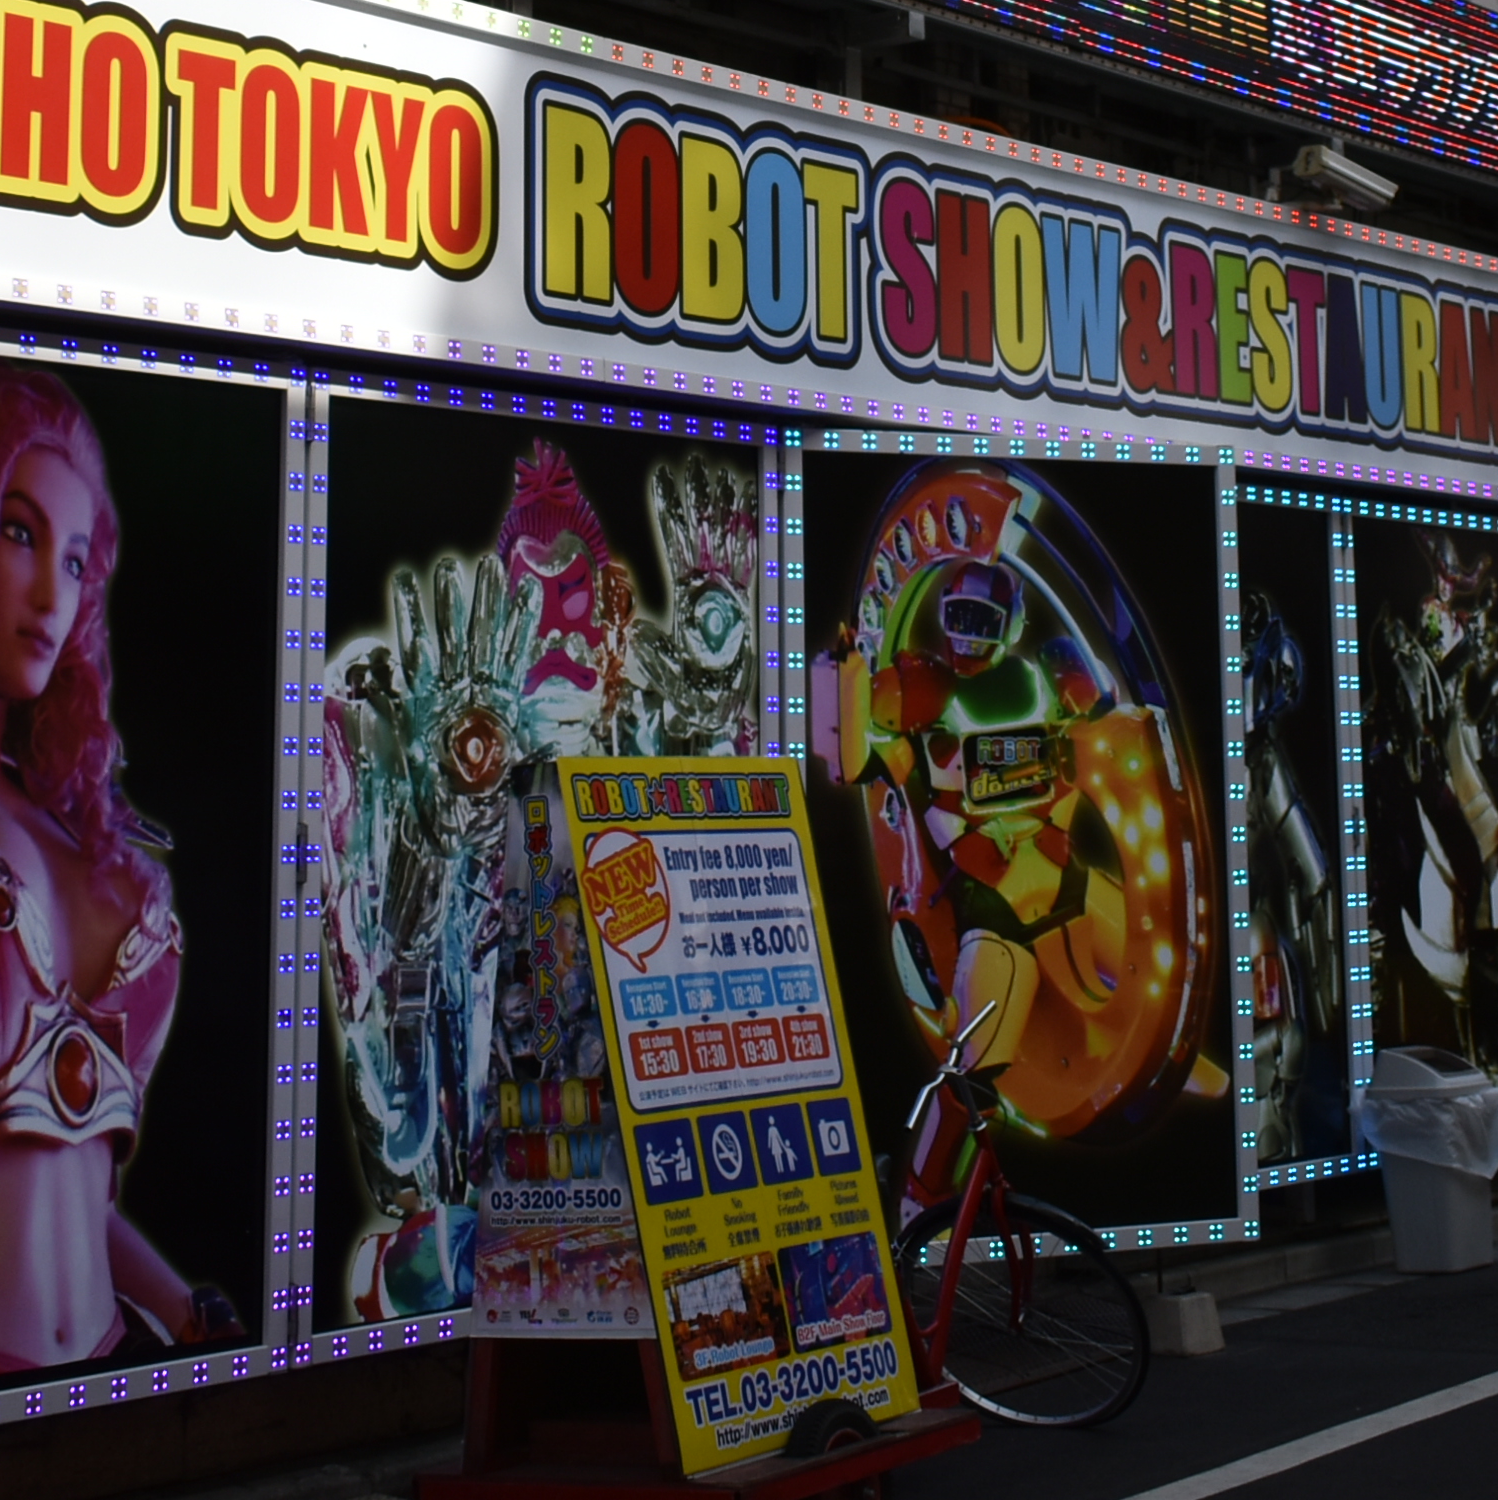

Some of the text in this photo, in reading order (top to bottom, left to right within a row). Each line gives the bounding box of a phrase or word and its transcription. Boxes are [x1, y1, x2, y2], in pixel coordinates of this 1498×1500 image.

[171, 46, 489, 264] TOKYO
[539, 96, 865, 350] ROBOT
[574, 777, 790, 817] ROBOT RESTAURANT
[583, 842, 655, 911] NEW
[663, 842, 793, 873] Entry fee 8,000 yen/
[689, 871, 798, 901] person per show
[525, 797, 561, 1059] ロボットレストラン
[639, 1049, 680, 1076] 15:30
[740, 1038, 779, 1064] 19:30
[791, 1033, 824, 1057] 21:30
[501, 1079, 604, 1128] ROBOT
[504, 1131, 601, 1181] SHOW
[490, 1187, 622, 1211] 03-3200-5500
